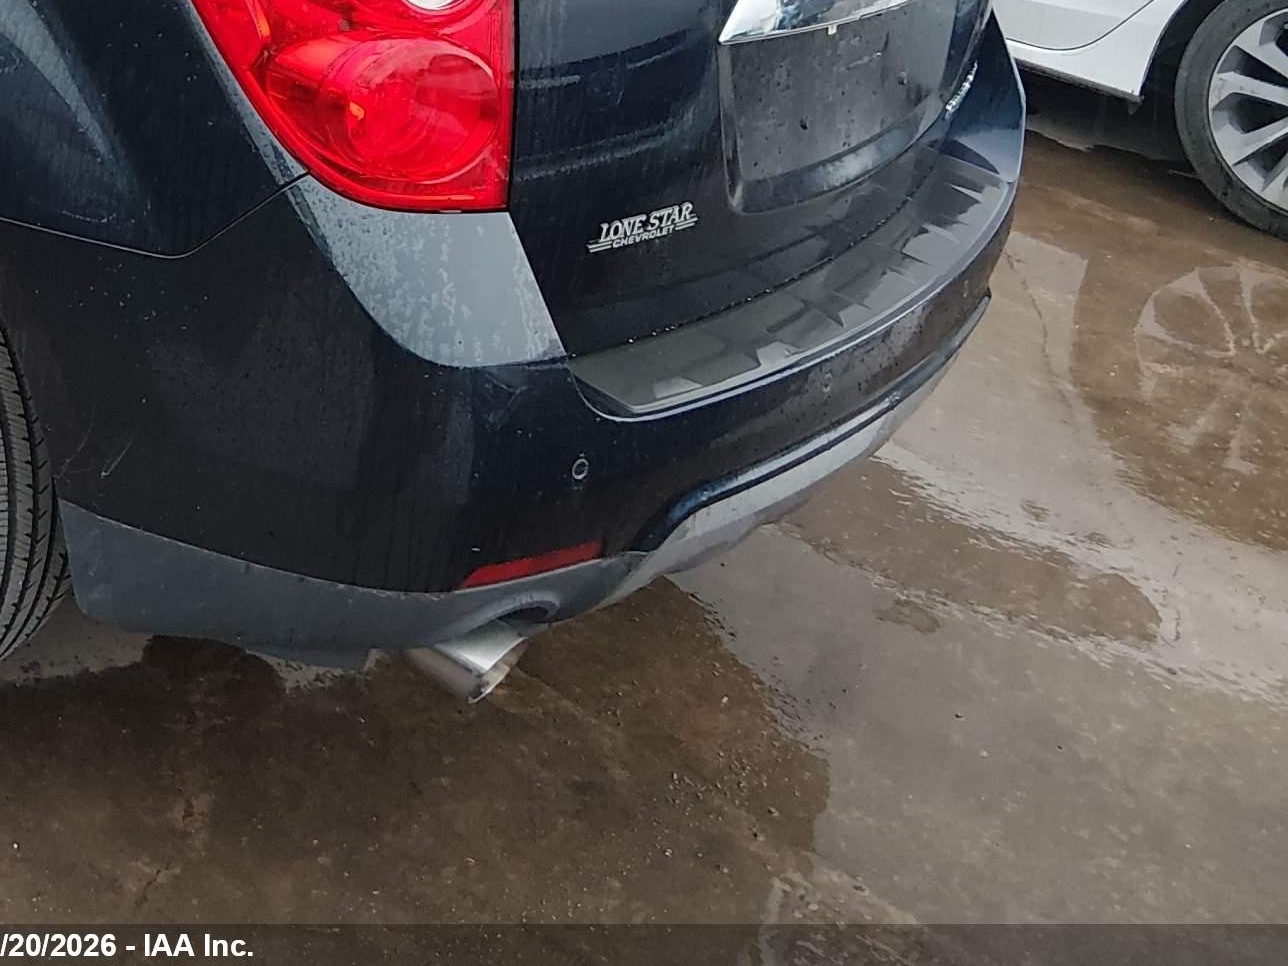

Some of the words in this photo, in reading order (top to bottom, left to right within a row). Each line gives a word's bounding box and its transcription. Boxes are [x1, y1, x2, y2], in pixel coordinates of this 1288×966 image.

[598, 213, 648, 244] LONE
[647, 201, 695, 231] STAR
[612, 224, 675, 249] CHEVROLET
